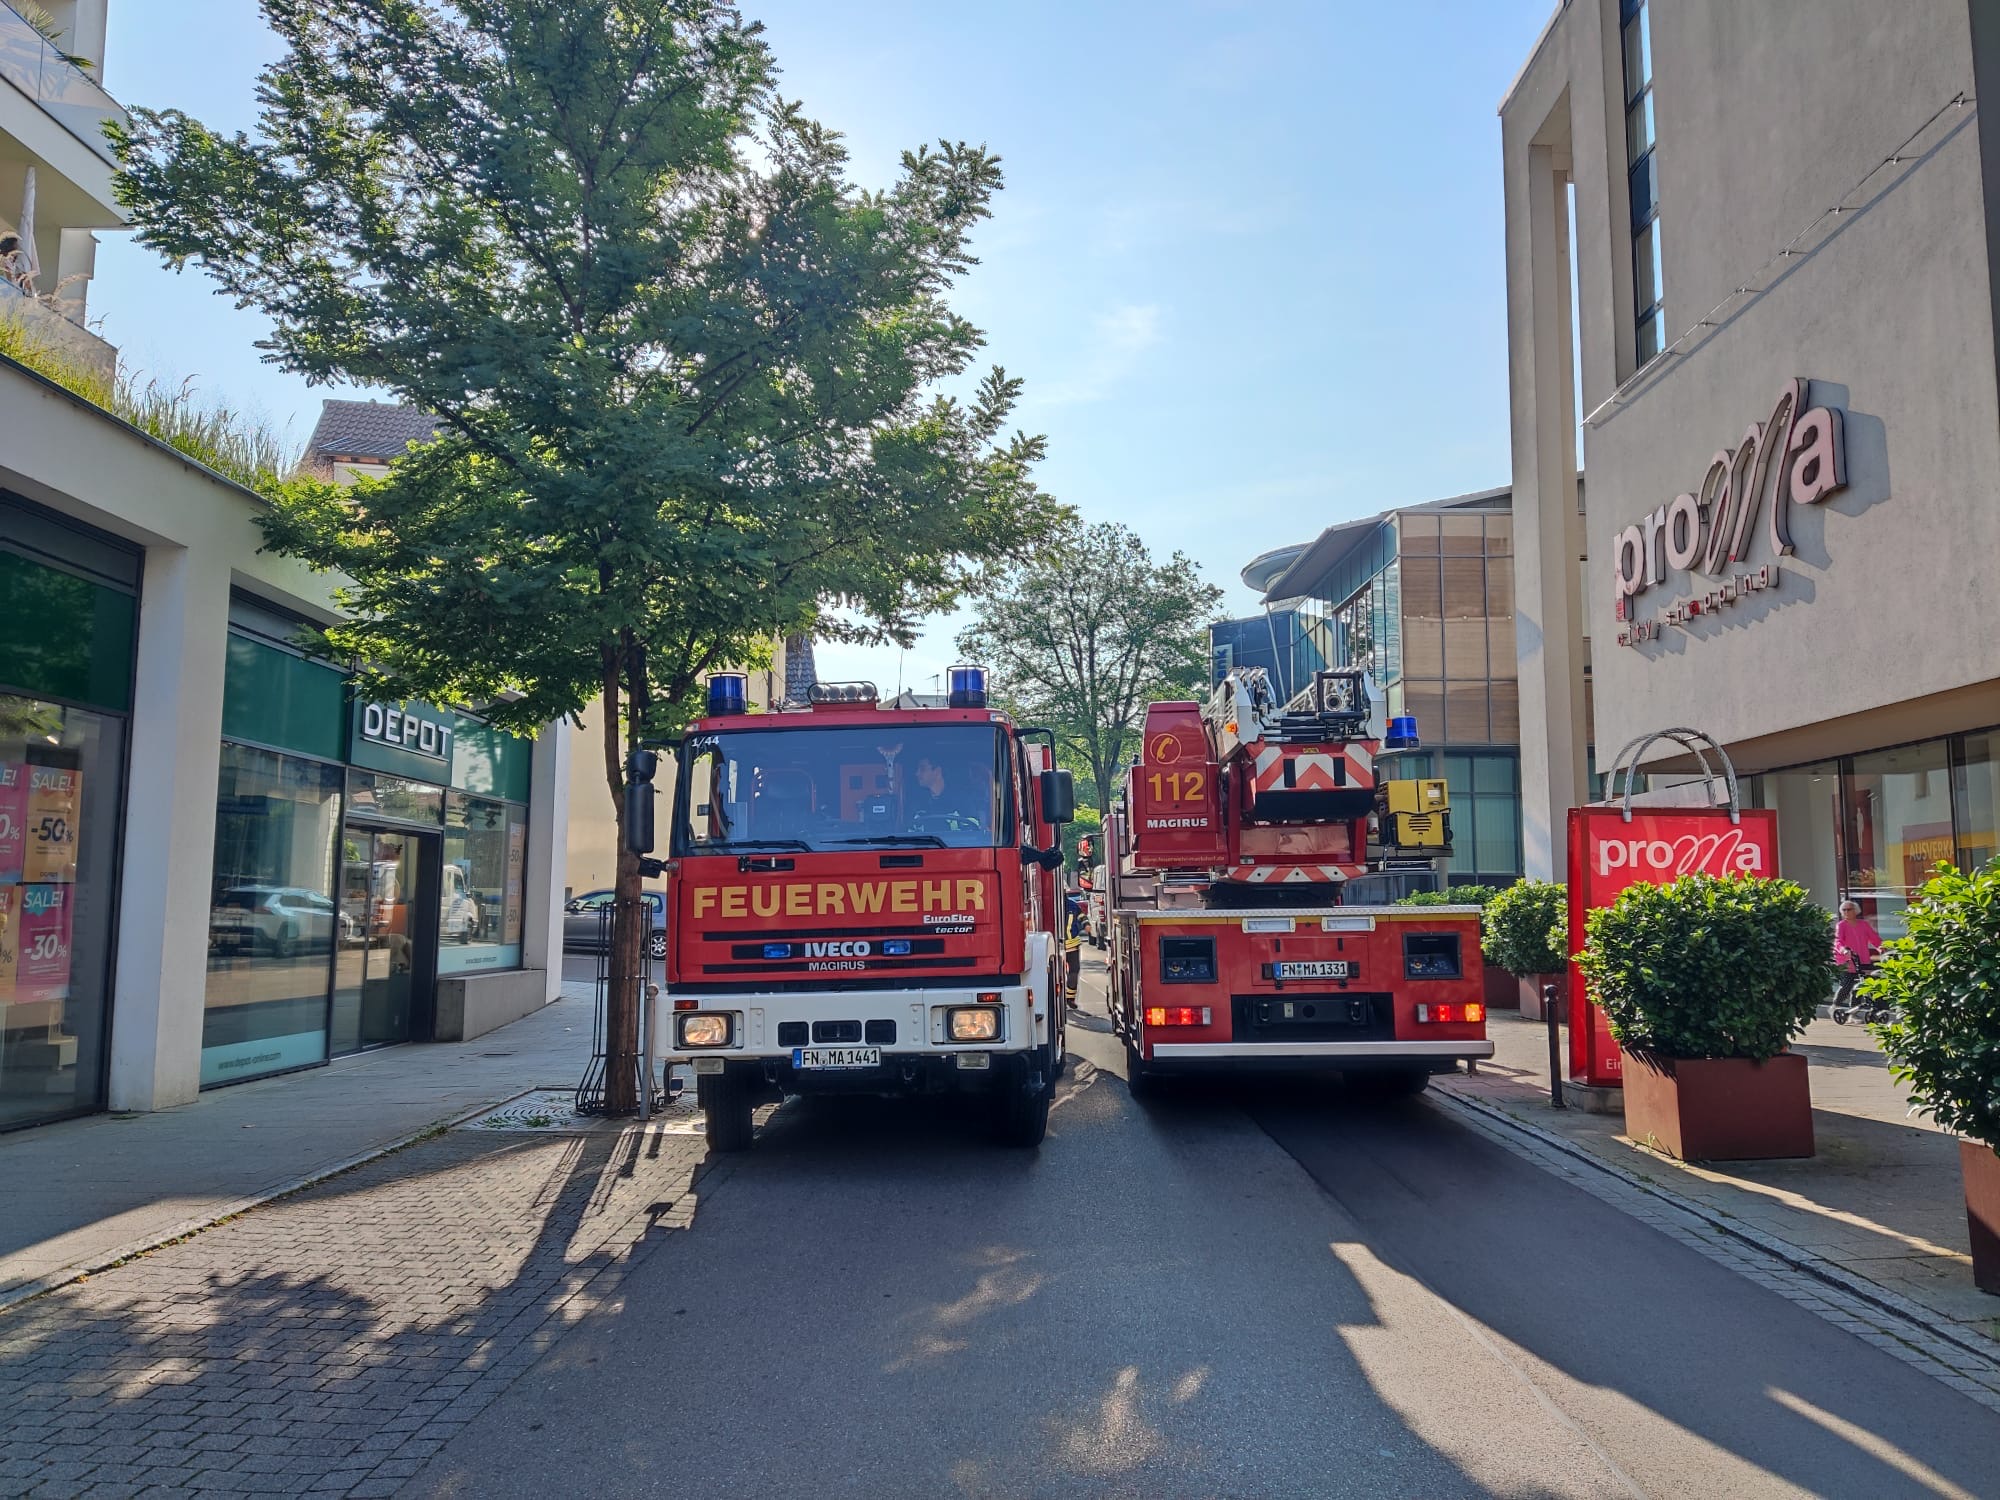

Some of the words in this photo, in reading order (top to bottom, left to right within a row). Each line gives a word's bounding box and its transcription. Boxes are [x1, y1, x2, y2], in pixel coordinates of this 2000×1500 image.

[364, 704, 452, 756] DEPOT
[691, 736, 720, 748] 1/44
[30, 772, 73, 792] SALE!
[1148, 772, 1205, 802] 112
[1146, 818, 1208, 829] MAGIRUS
[23, 890, 64, 909] SALE!
[693, 879, 985, 919] FEUERWEHR
[935, 926, 973, 934] tector
[24, 934, 67, 961] -30%
[804, 941, 871, 958] IVECO
[808, 960, 866, 972] MAGIRUS
[1281, 963, 1296, 976] FN
[1303, 963, 1318, 976] MA
[1319, 963, 1347, 976] 1331
[802, 1050, 819, 1066] FN
[828, 1050, 845, 1065] MA
[847, 1049, 879, 1065] 1441
